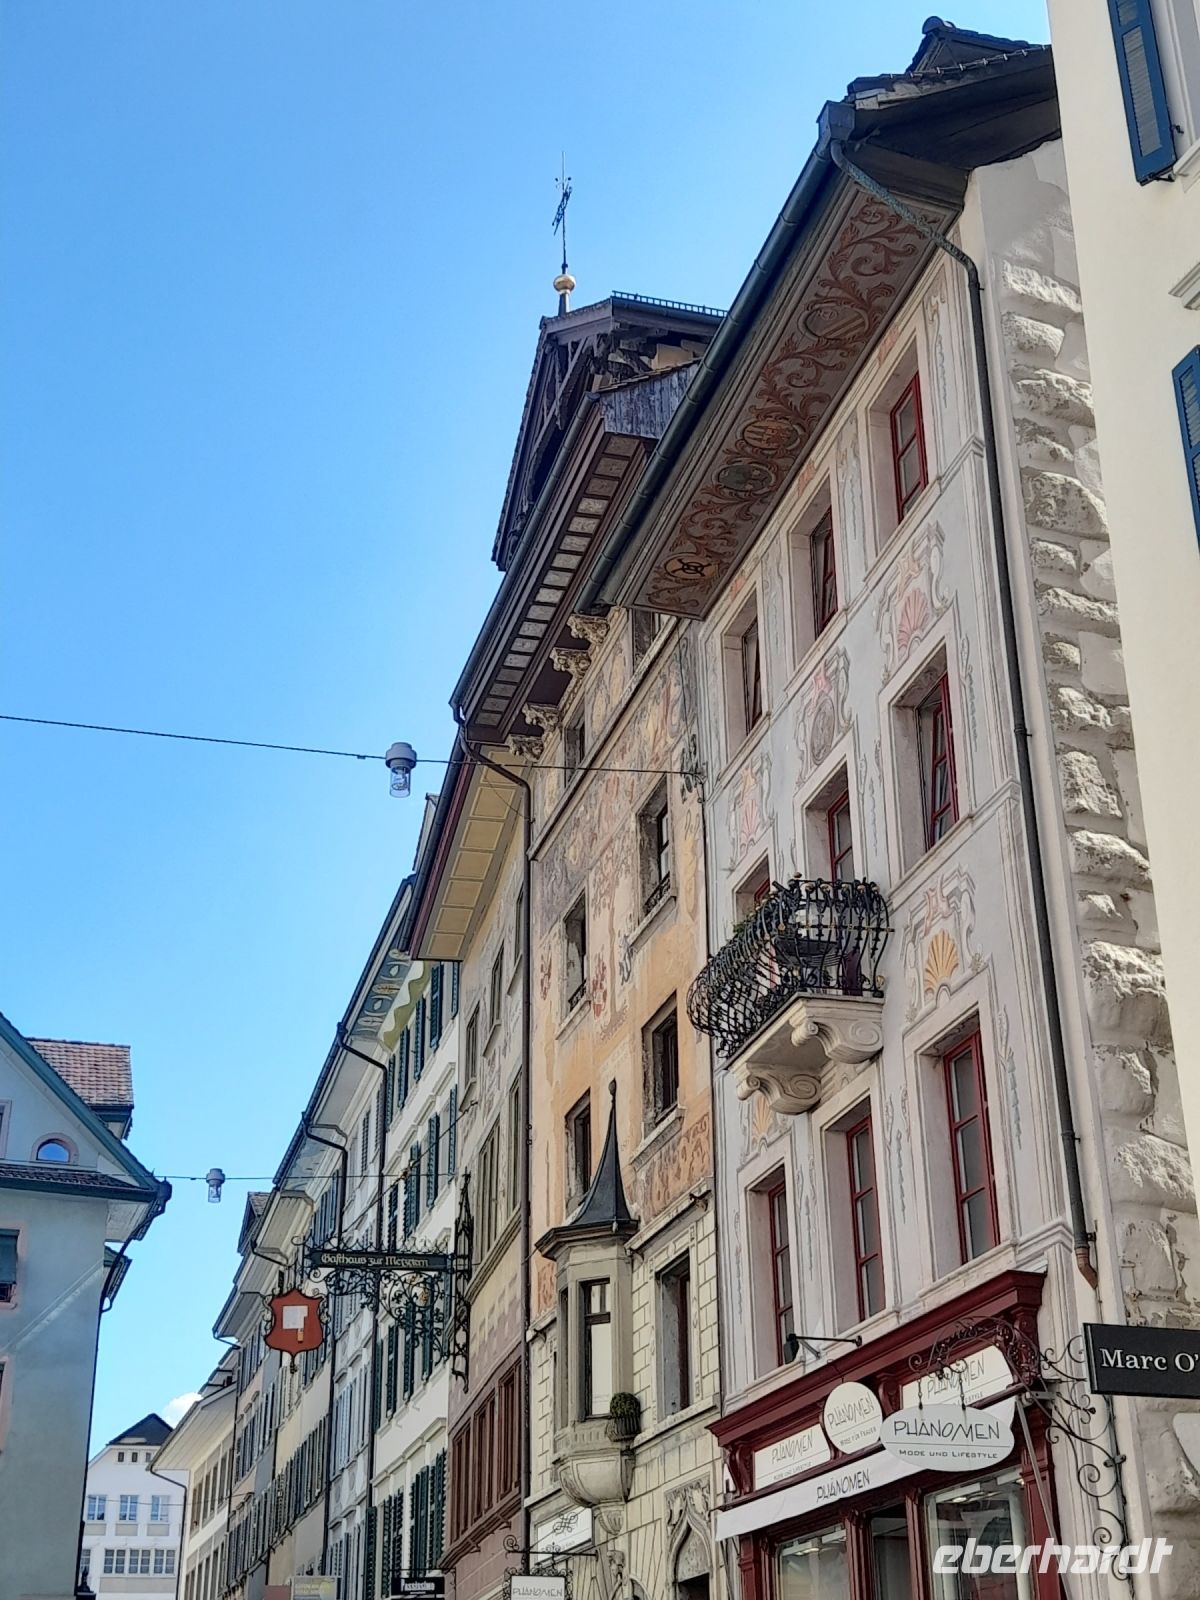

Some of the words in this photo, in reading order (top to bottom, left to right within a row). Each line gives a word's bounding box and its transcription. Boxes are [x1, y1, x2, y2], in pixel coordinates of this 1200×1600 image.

[367, 1256, 383, 1266] zur
[1099, 1348, 1168, 1371] Marc
[893, 1417, 1000, 1443] PHÄNOMEN
[816, 1468, 871, 1503] PHÄNOMEN
